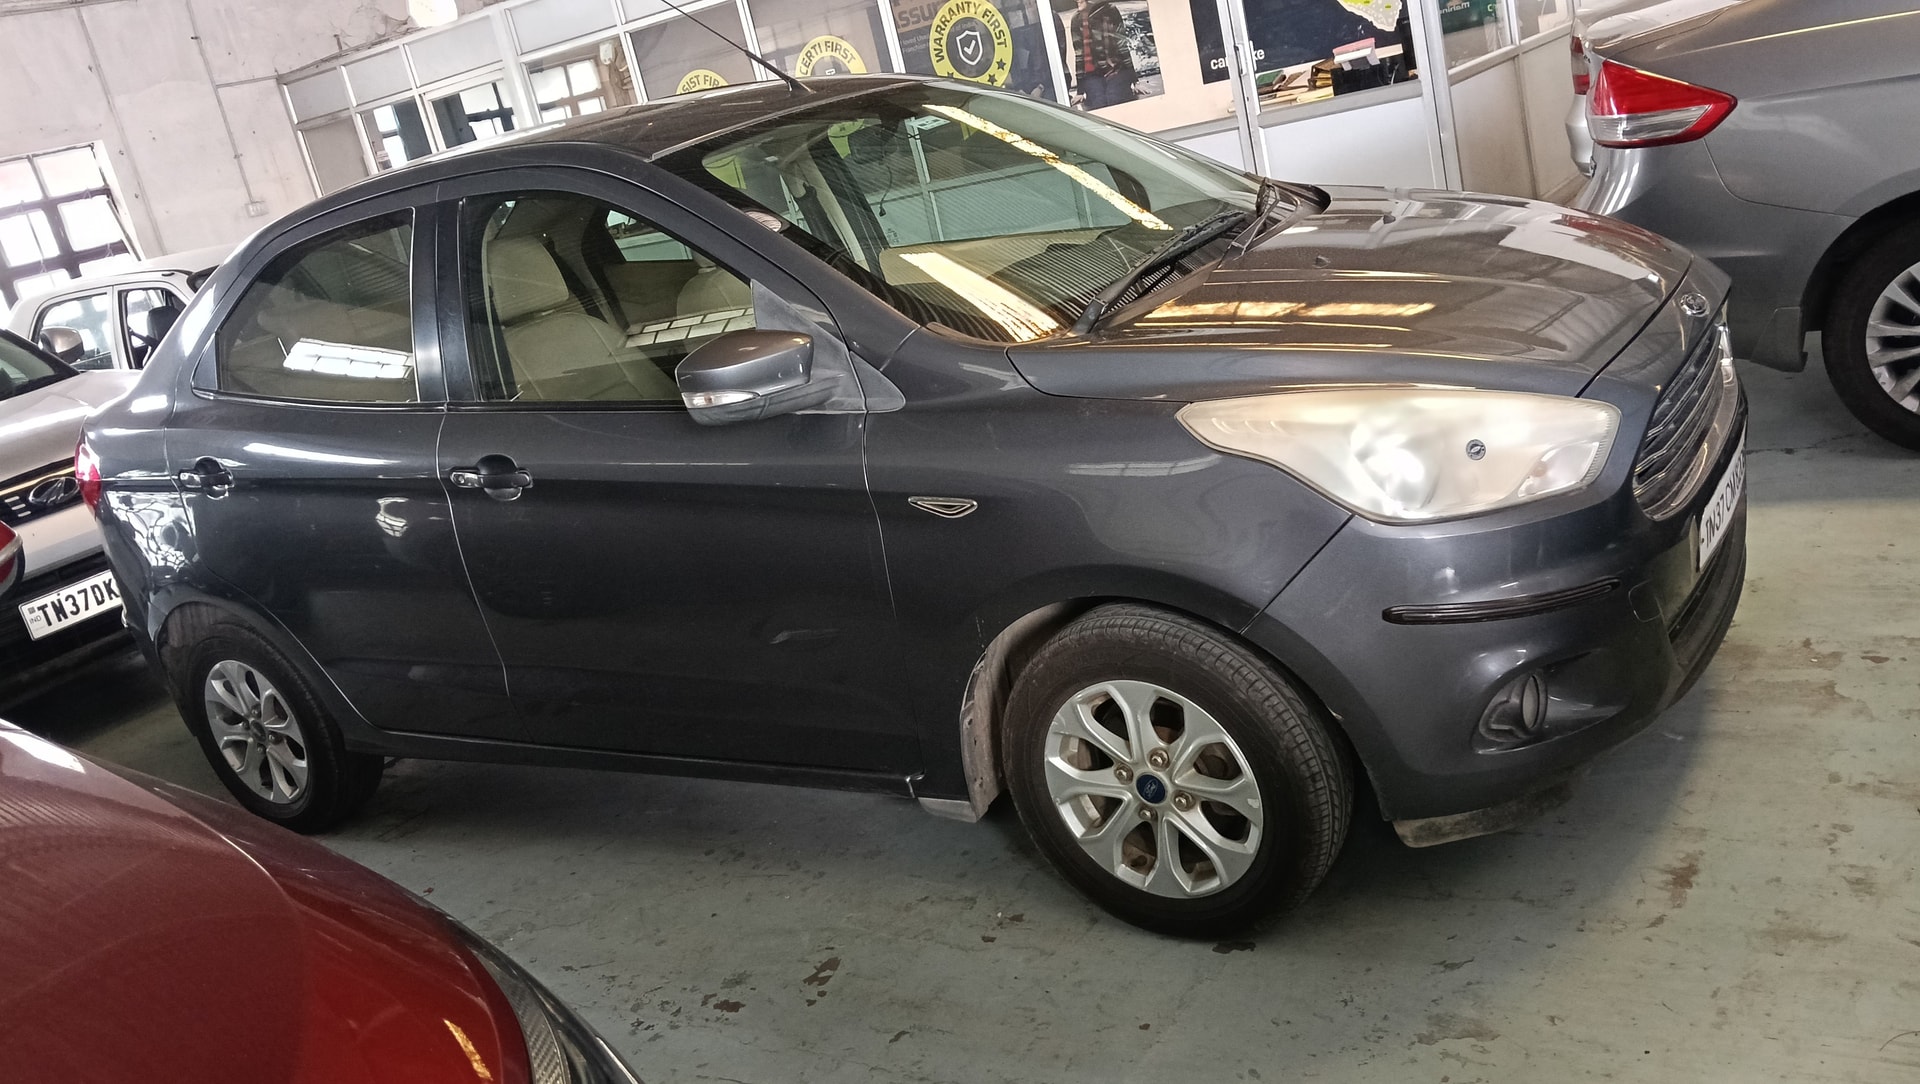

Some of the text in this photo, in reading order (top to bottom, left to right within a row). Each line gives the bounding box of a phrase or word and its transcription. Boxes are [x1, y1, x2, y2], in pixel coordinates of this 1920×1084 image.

[933, 1, 1007, 63] WARRANTY FIRST
[799, 40, 856, 76] CERTI FIRST
[36, 578, 121, 627] TN37DK
